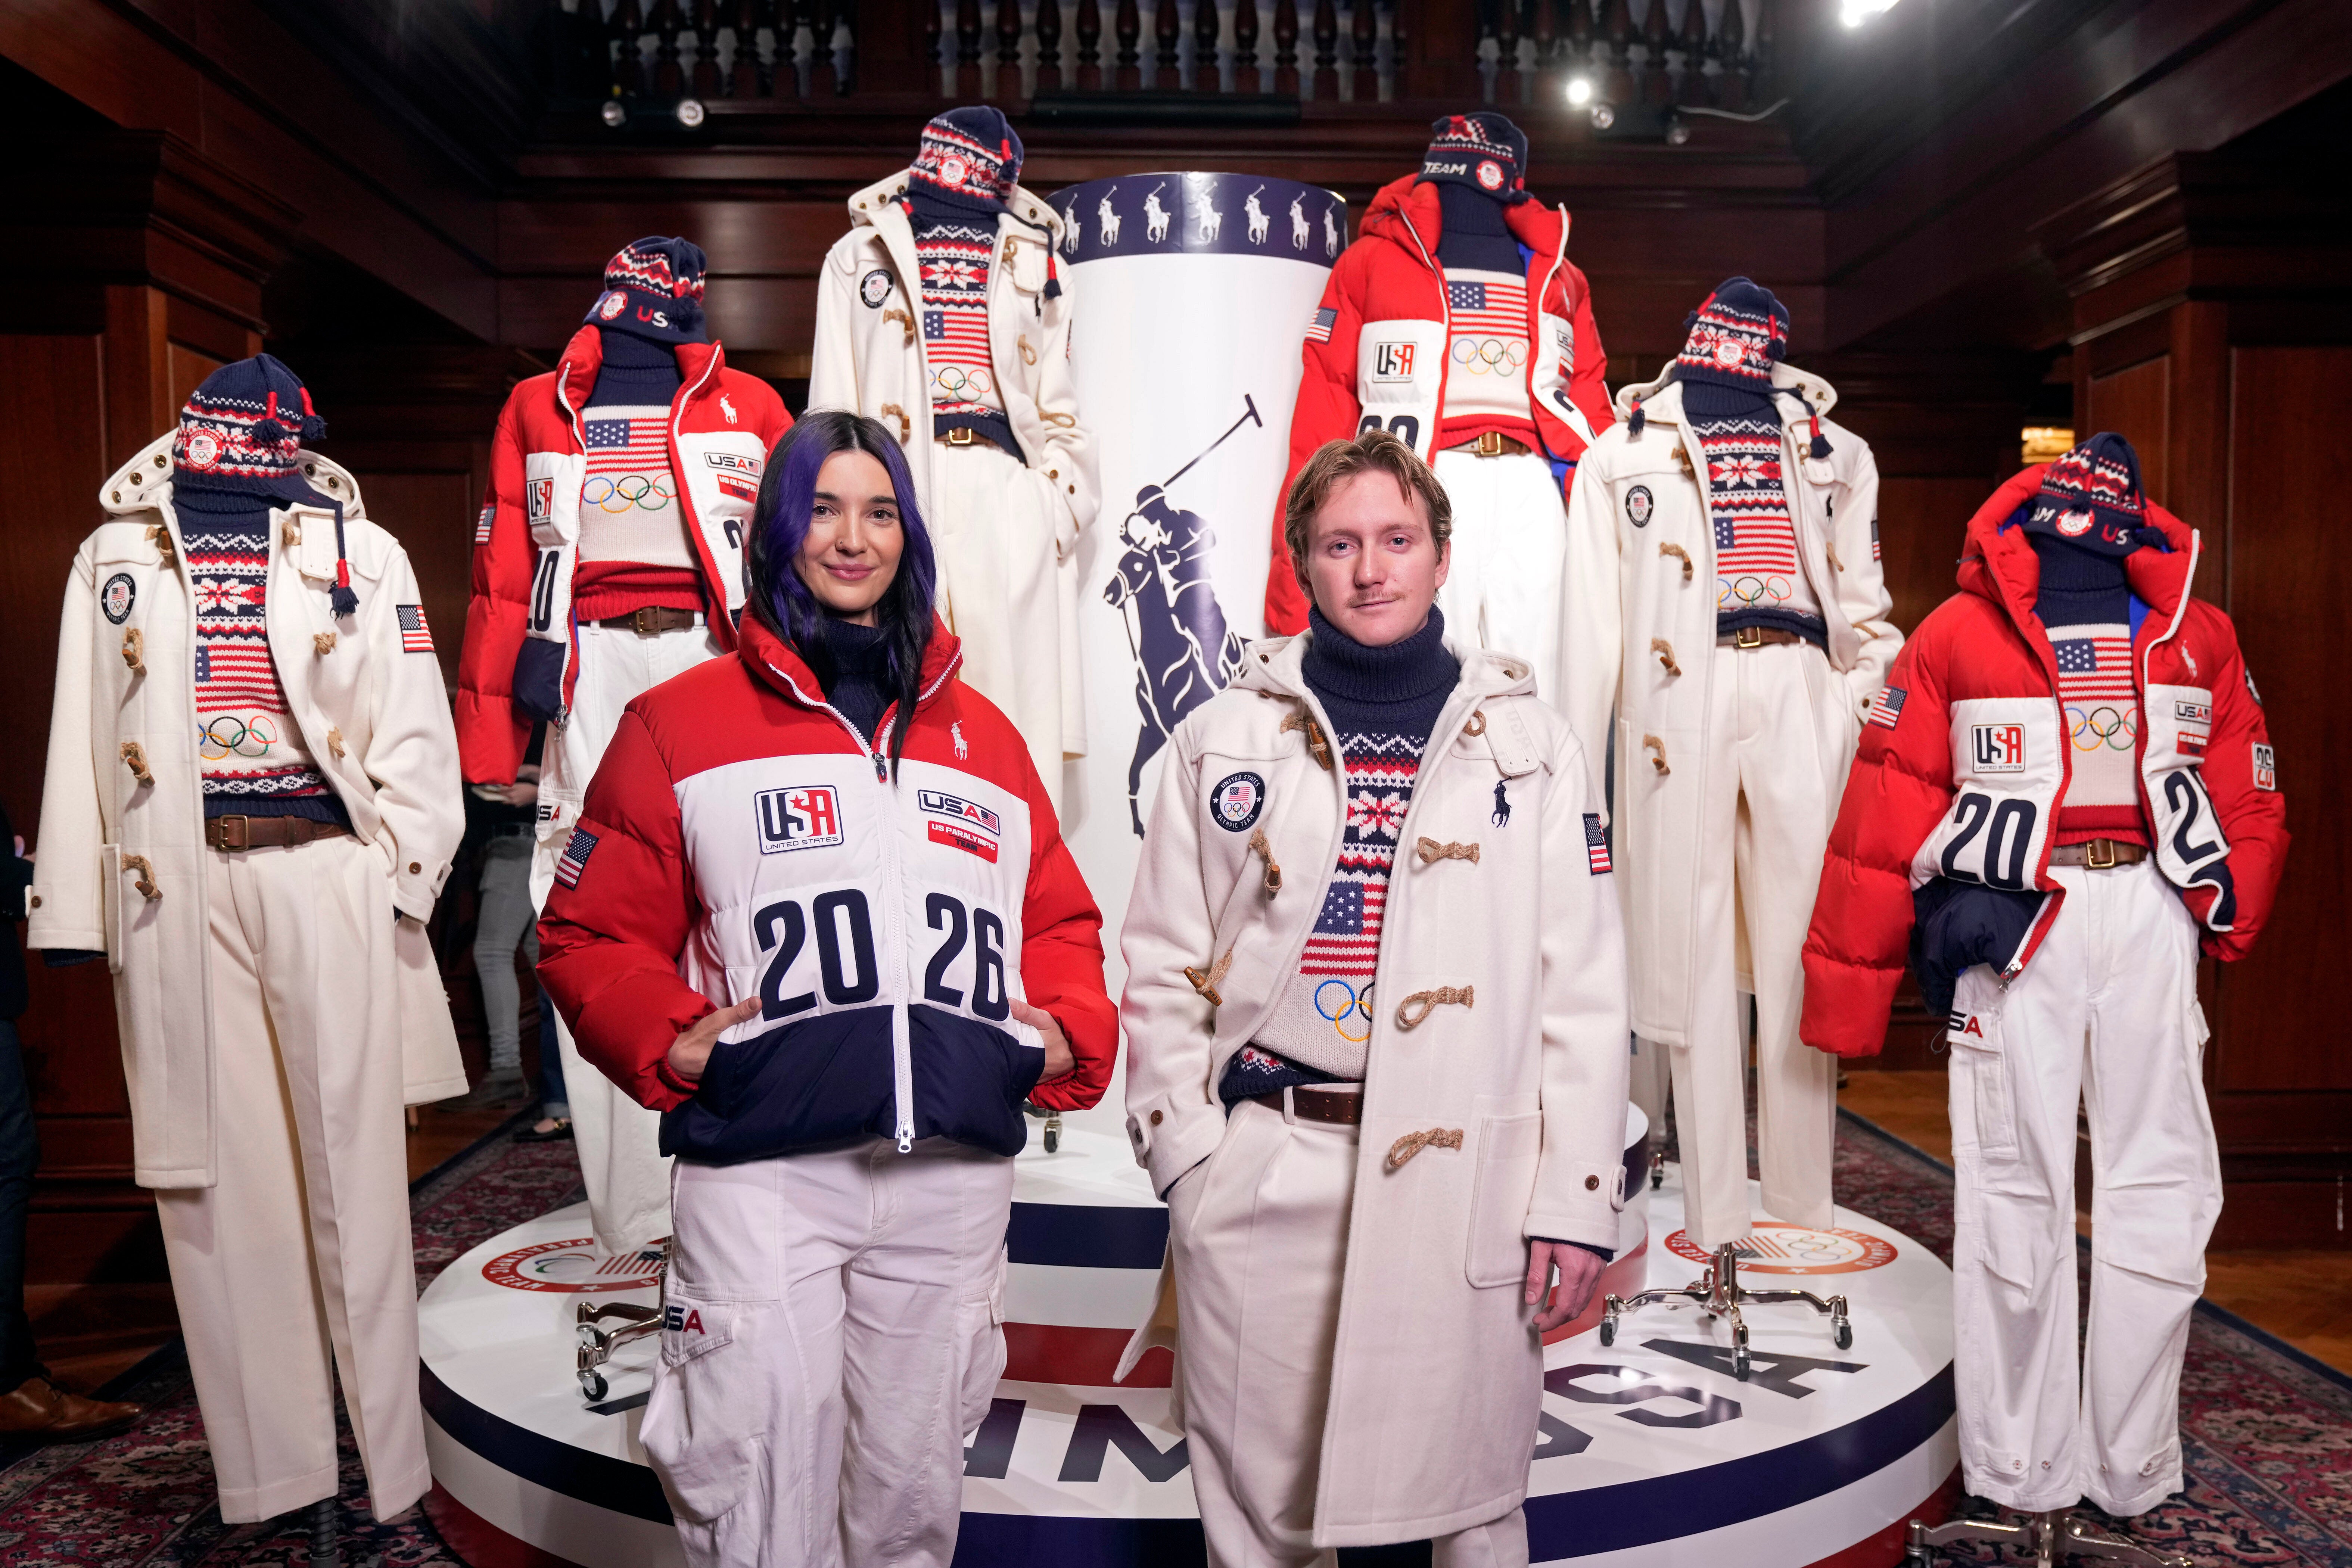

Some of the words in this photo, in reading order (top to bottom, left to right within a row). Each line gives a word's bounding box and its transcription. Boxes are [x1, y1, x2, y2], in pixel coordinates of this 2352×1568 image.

[1423, 161, 1468, 175] TEAM
[1377, 345, 1414, 375] USA
[708, 455, 748, 470] USA
[730, 478, 757, 492] OLYMPIC
[529, 481, 553, 517] USA
[2178, 704, 2204, 719] USA
[1976, 727, 2022, 763] USA
[1220, 775, 1242, 788] UNITED
[1243, 774, 1260, 787] STATES
[761, 790, 836, 841] USA
[923, 794, 982, 822] USA
[1217, 813, 1238, 828] OLYMPIC
[1240, 813, 1254, 827] TEAM
[766, 841, 799, 850] UNITED
[802, 836, 838, 844] STATES
[932, 823, 945, 831] US
[946, 827, 996, 851] PARALYMPIC
[955, 839, 977, 852] TEAM
[1941, 793, 2037, 889] 20
[754, 889, 879, 1022] 20
[924, 893, 1009, 1021] 26
[489, 1239, 588, 1274] PARALYMPIC
[495, 1275, 545, 1289] TEAM
